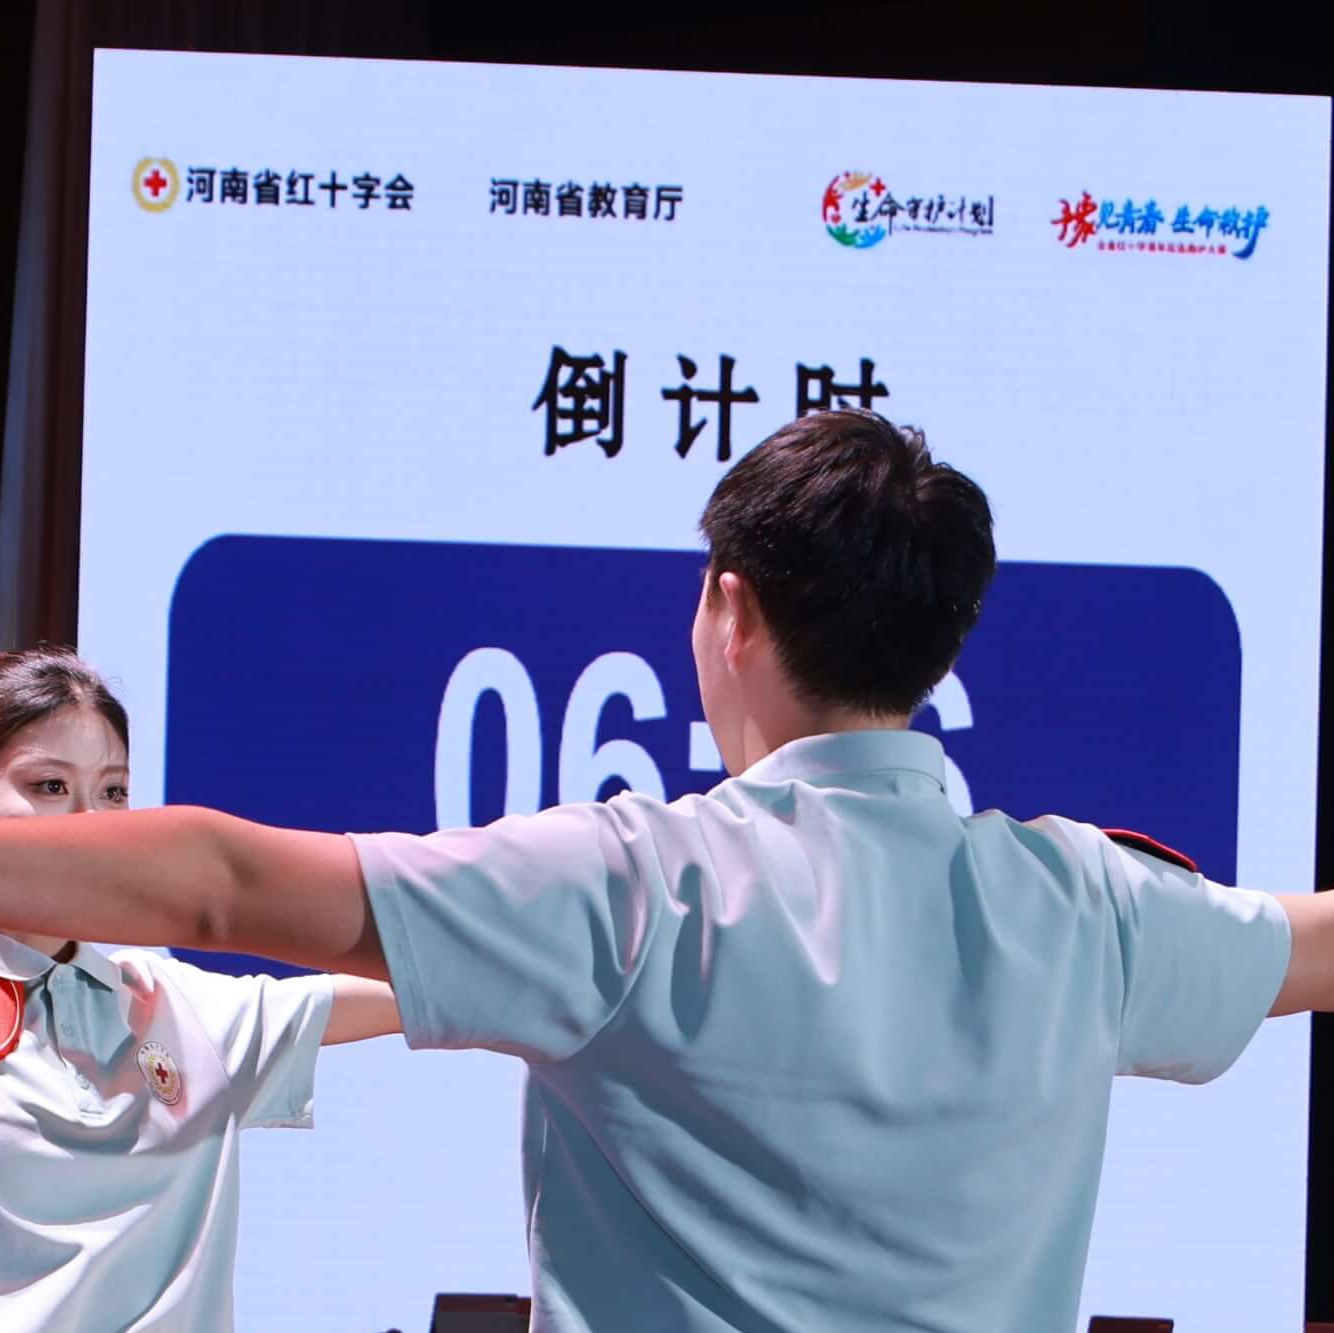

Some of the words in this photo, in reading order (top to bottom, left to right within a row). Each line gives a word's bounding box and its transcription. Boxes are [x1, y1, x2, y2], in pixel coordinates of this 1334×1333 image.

[185, 166, 415, 212] 河南省红十字会
[489, 177, 684, 221] 河南省教育厅
